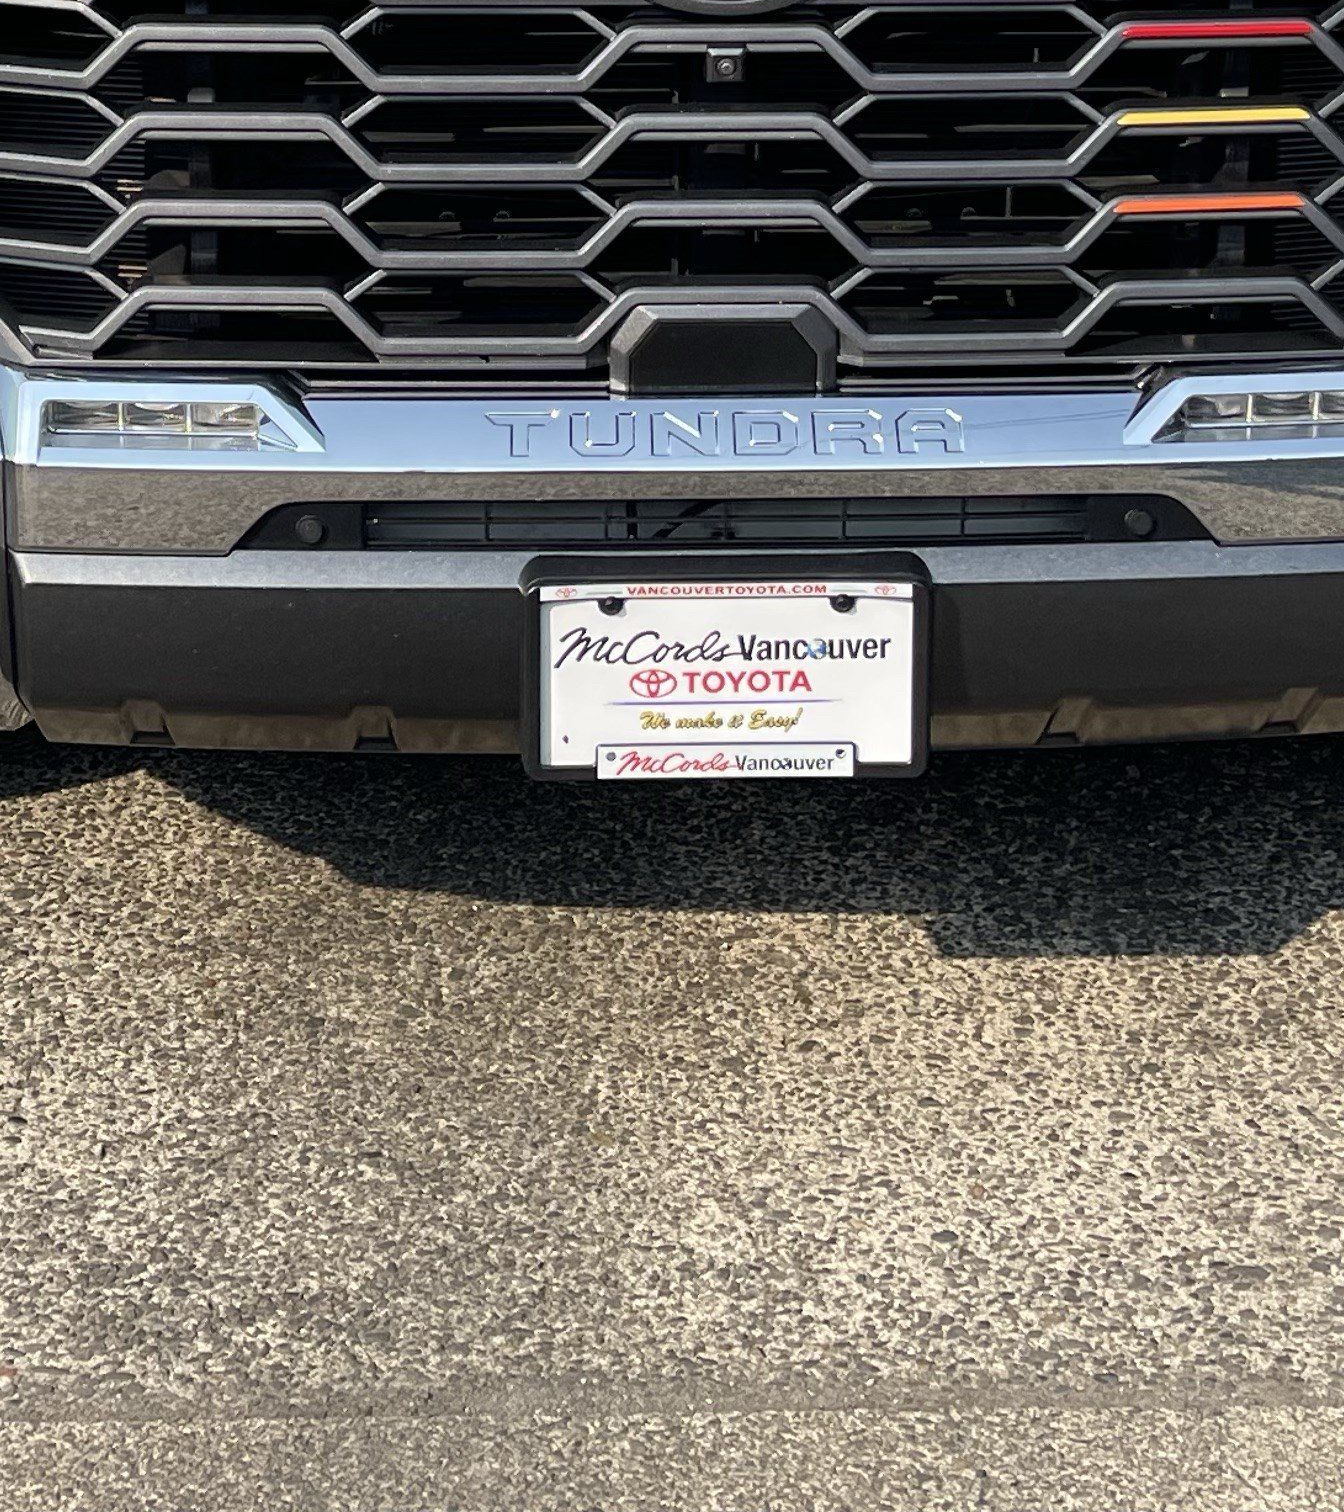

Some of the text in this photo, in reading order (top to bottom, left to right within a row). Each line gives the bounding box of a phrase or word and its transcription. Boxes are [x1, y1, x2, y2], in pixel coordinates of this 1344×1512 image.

[484, 408, 965, 457] TUNDRA
[627, 584, 827, 596] VANCOUVERTOYOTA.COM
[554, 627, 733, 669] McCords
[682, 670, 812, 693] TOYOTA
[639, 710, 671, 730] We
